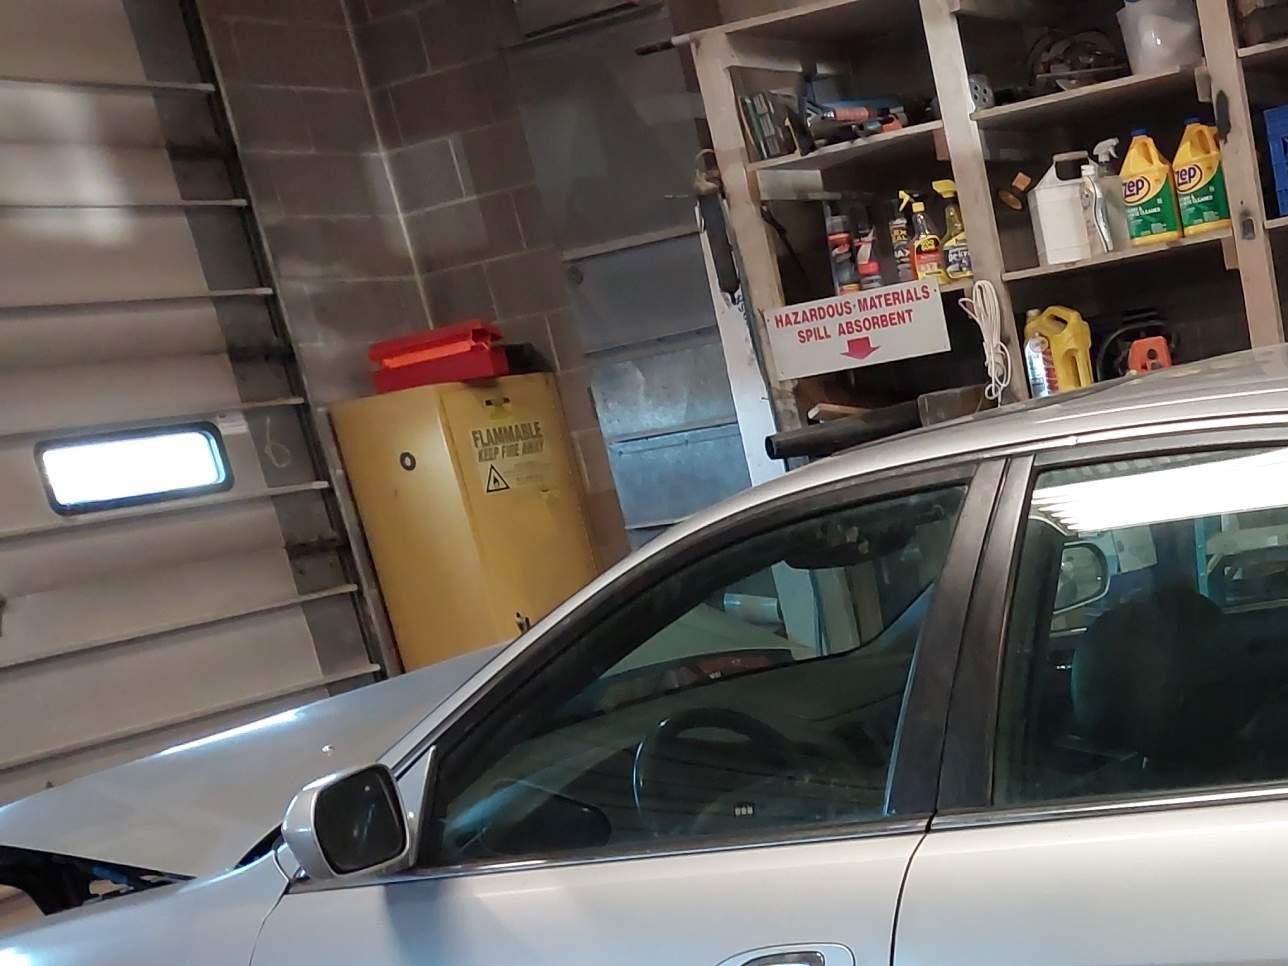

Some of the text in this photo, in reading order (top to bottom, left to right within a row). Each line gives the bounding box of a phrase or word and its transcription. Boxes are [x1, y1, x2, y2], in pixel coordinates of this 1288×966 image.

[774, 300, 853, 330] HAZARDOUS
[857, 284, 931, 313] MATERIALS
[797, 308, 914, 345] SPILL ABSORBENT
[471, 421, 544, 449] FLAMMABLE
[478, 446, 500, 463] KEEP
[501, 443, 520, 460] FIRE
